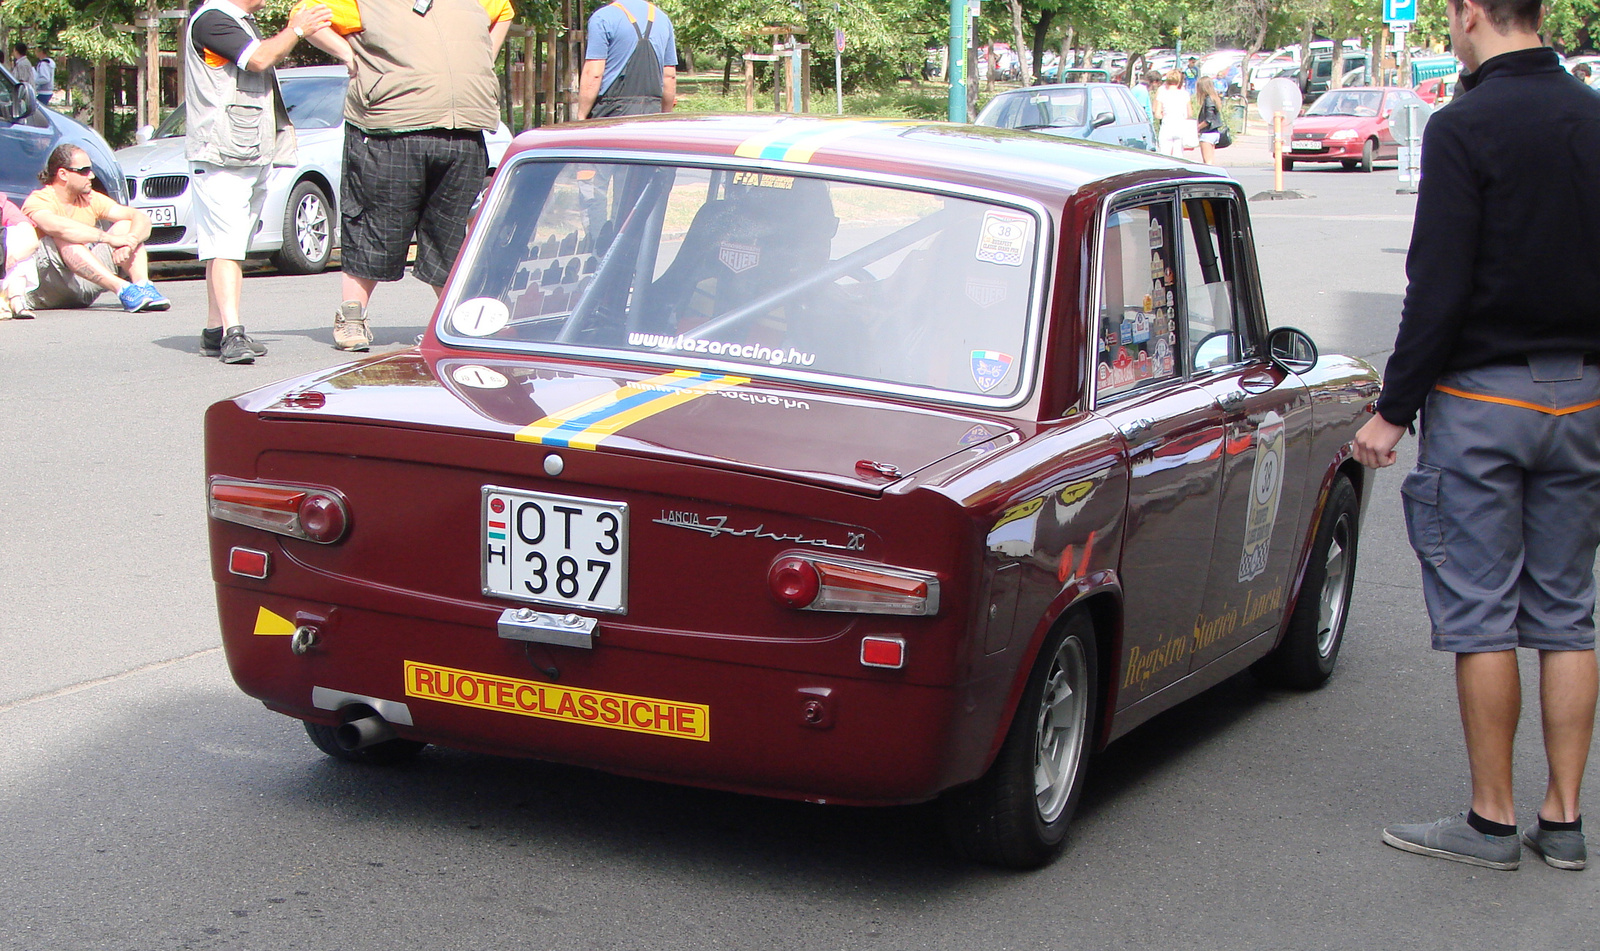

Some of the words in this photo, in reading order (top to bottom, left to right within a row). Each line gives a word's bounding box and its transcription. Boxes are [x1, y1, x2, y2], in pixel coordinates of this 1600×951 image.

[1389, 0, 1411, 18] P
[998, 225, 1011, 237] 38
[722, 249, 758, 270] HEUER
[628, 332, 816, 366] www.lazaracing.hu
[978, 376, 996, 388] ASI
[1261, 460, 1273, 494] 38
[661, 509, 700, 526] LANCIA
[846, 532, 865, 551] 2C
[488, 543, 506, 565] H
[524, 551, 612, 601] 387
[1122, 634, 1187, 692] Registro
[1190, 602, 1238, 654] Storico
[1241, 576, 1282, 627] Lancia
[414, 667, 696, 734] RUOTECLASSICHE
